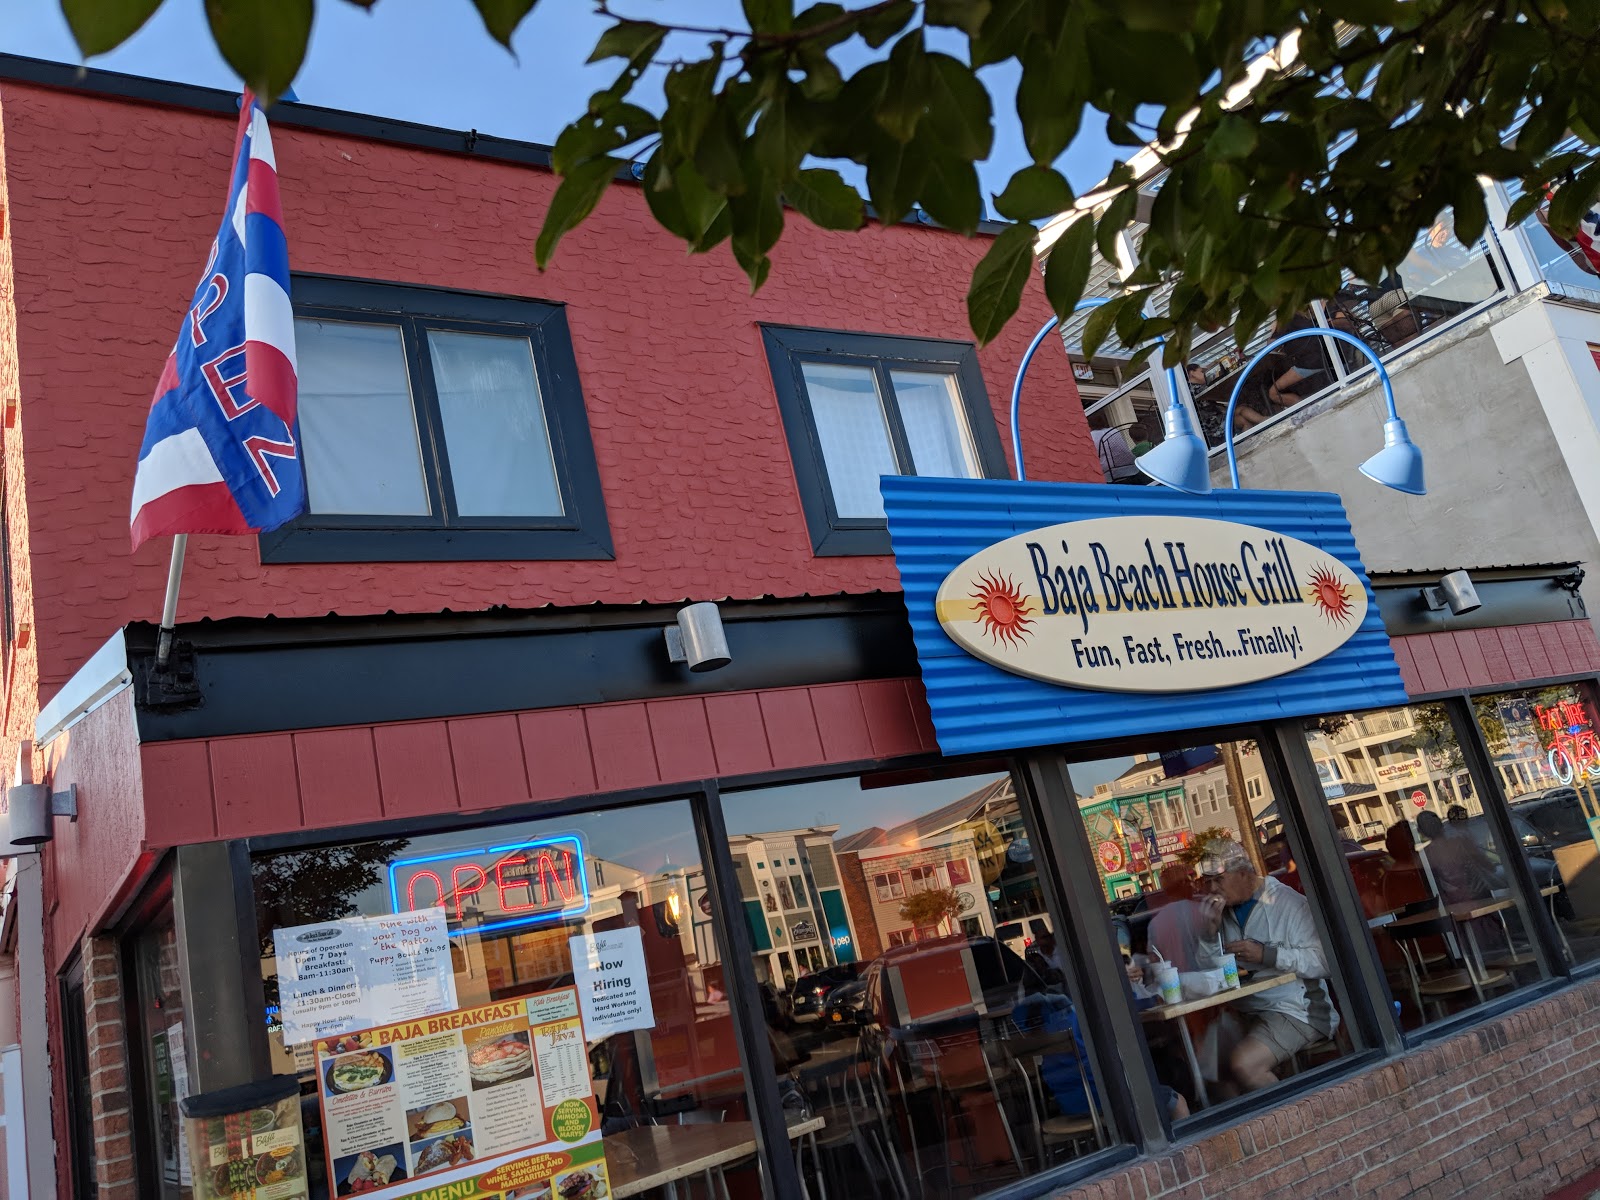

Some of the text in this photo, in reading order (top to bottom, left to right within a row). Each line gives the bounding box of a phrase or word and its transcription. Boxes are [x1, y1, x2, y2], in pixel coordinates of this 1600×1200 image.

[199, 236, 297, 498] PEN
[1026, 537, 1304, 635] Baja Beach House Grill
[1071, 638, 1121, 671] Fun,
[1123, 635, 1173, 667] Fast,
[1535, 700, 1588, 731] FAT TIRE
[407, 850, 576, 921] OPEN
[380, 915, 428, 930] Dine with
[372, 932, 396, 945] your
[401, 928, 420, 937] Dog
[380, 937, 433, 951] the Patio.
[836, 935, 850, 946] pep
[319, 942, 354, 953] Operation
[369, 955, 394, 965] Puppy
[424, 944, 446, 955] $6.95
[295, 956, 317, 964] Open
[328, 951, 347, 959] Days
[304, 959, 346, 971] Breakfast:
[298, 966, 354, 981] 8am-11:30am
[596, 960, 624, 972] Now
[293, 982, 357, 999] Lunch & Dinner:
[593, 977, 631, 992] Hiring
[296, 991, 356, 1007] 11:30am-Close
[592, 993, 624, 1003] Dedicated
[595, 999, 637, 1012] Hard Working
[318, 1003, 332, 1012] 9pm
[592, 1011, 626, 1022] Individuals
[627, 1006, 642, 1016] only!
[301, 1021, 321, 1029] Happy
[322, 1017, 337, 1025] Hour
[379, 1023, 425, 1046] BAJA
[428, 1002, 520, 1035] BREAKFAST
[556, 1112, 588, 1120] MIMOSAS
[557, 1106, 586, 1114] SERVING
[558, 1124, 585, 1132] BLOODY
[486, 1157, 564, 1185] WINE, SANGRIA AND
[496, 1153, 552, 1175] SERVING BEER,
[500, 1169, 552, 1189] MARGARITAS!
[420, 1180, 475, 1200] MENU
